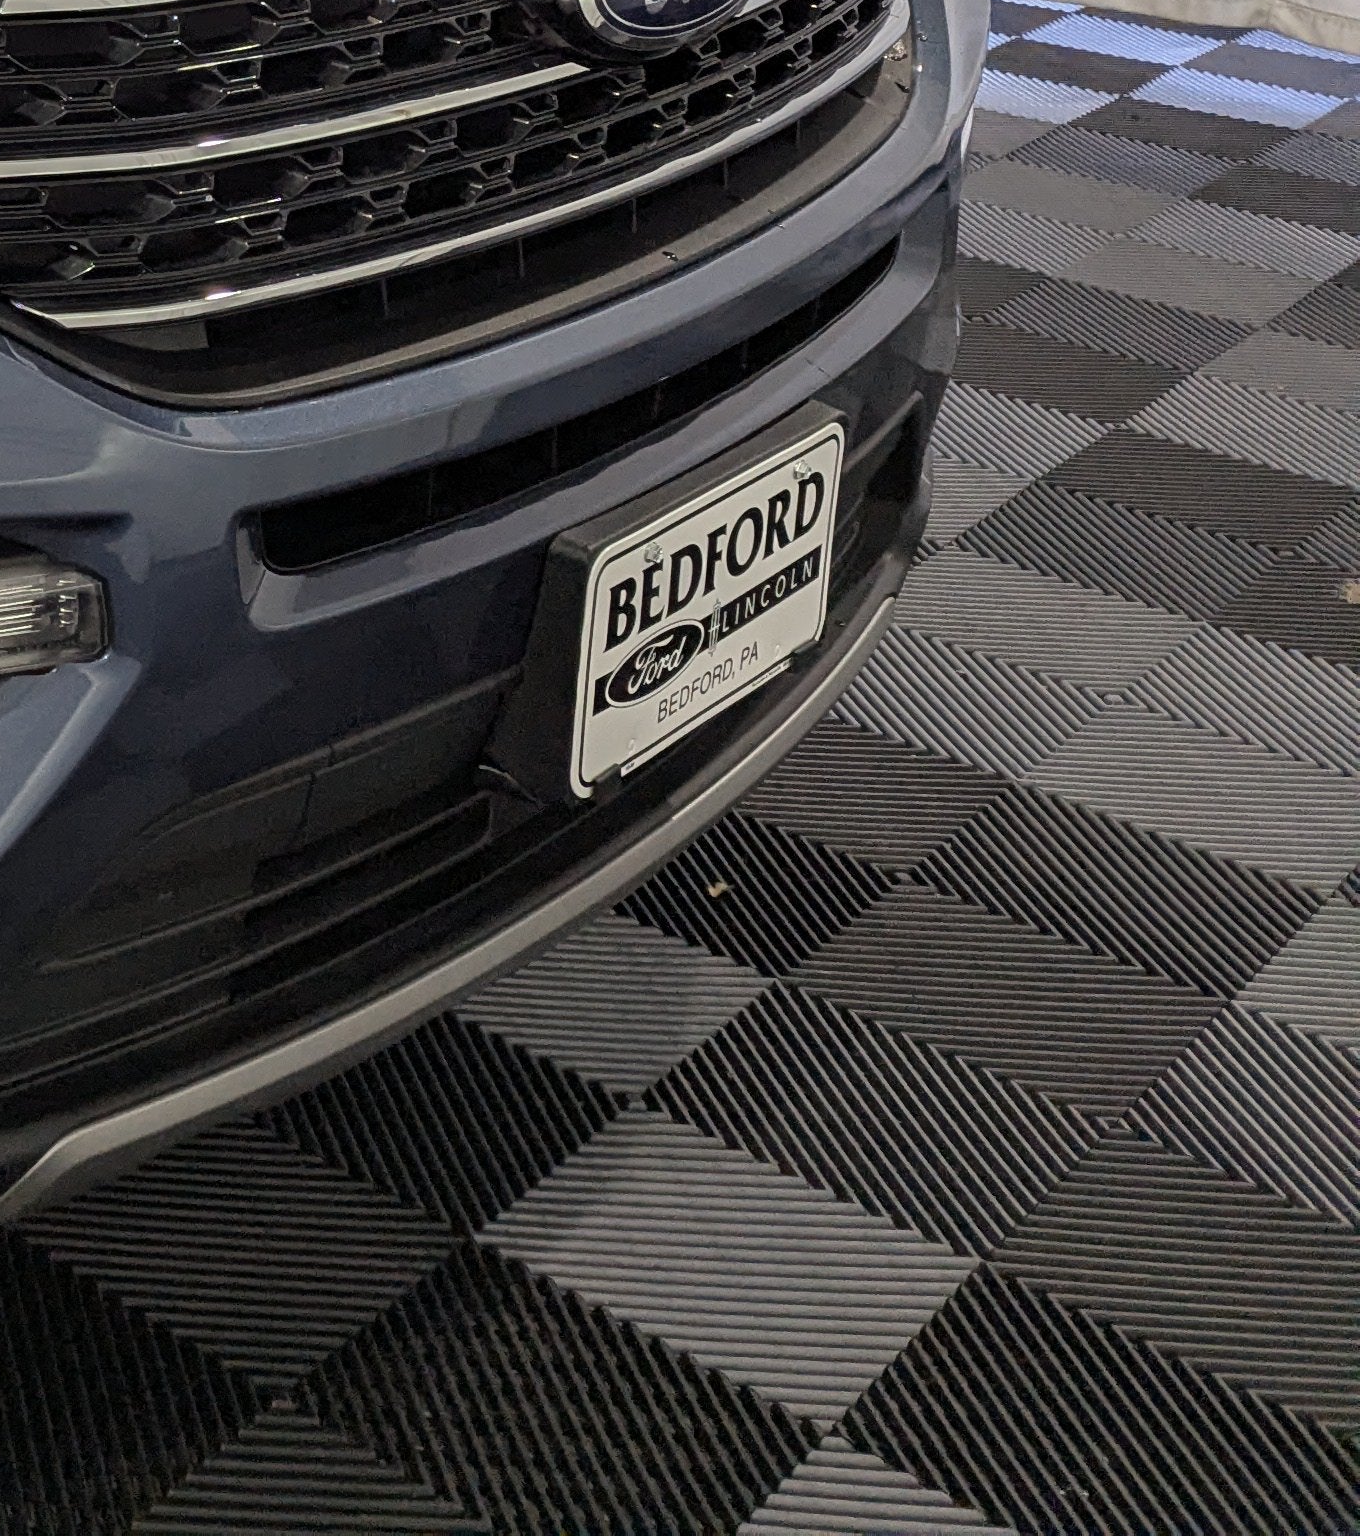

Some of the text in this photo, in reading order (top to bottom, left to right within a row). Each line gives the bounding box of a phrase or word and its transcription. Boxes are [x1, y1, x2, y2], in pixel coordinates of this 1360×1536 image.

[603, 471, 825, 654] BEDFORD
[626, 637, 688, 695] Ford
[720, 556, 814, 634] LINCOLN
[657, 661, 735, 724] BEDFORD,
[739, 640, 760, 672] PA
